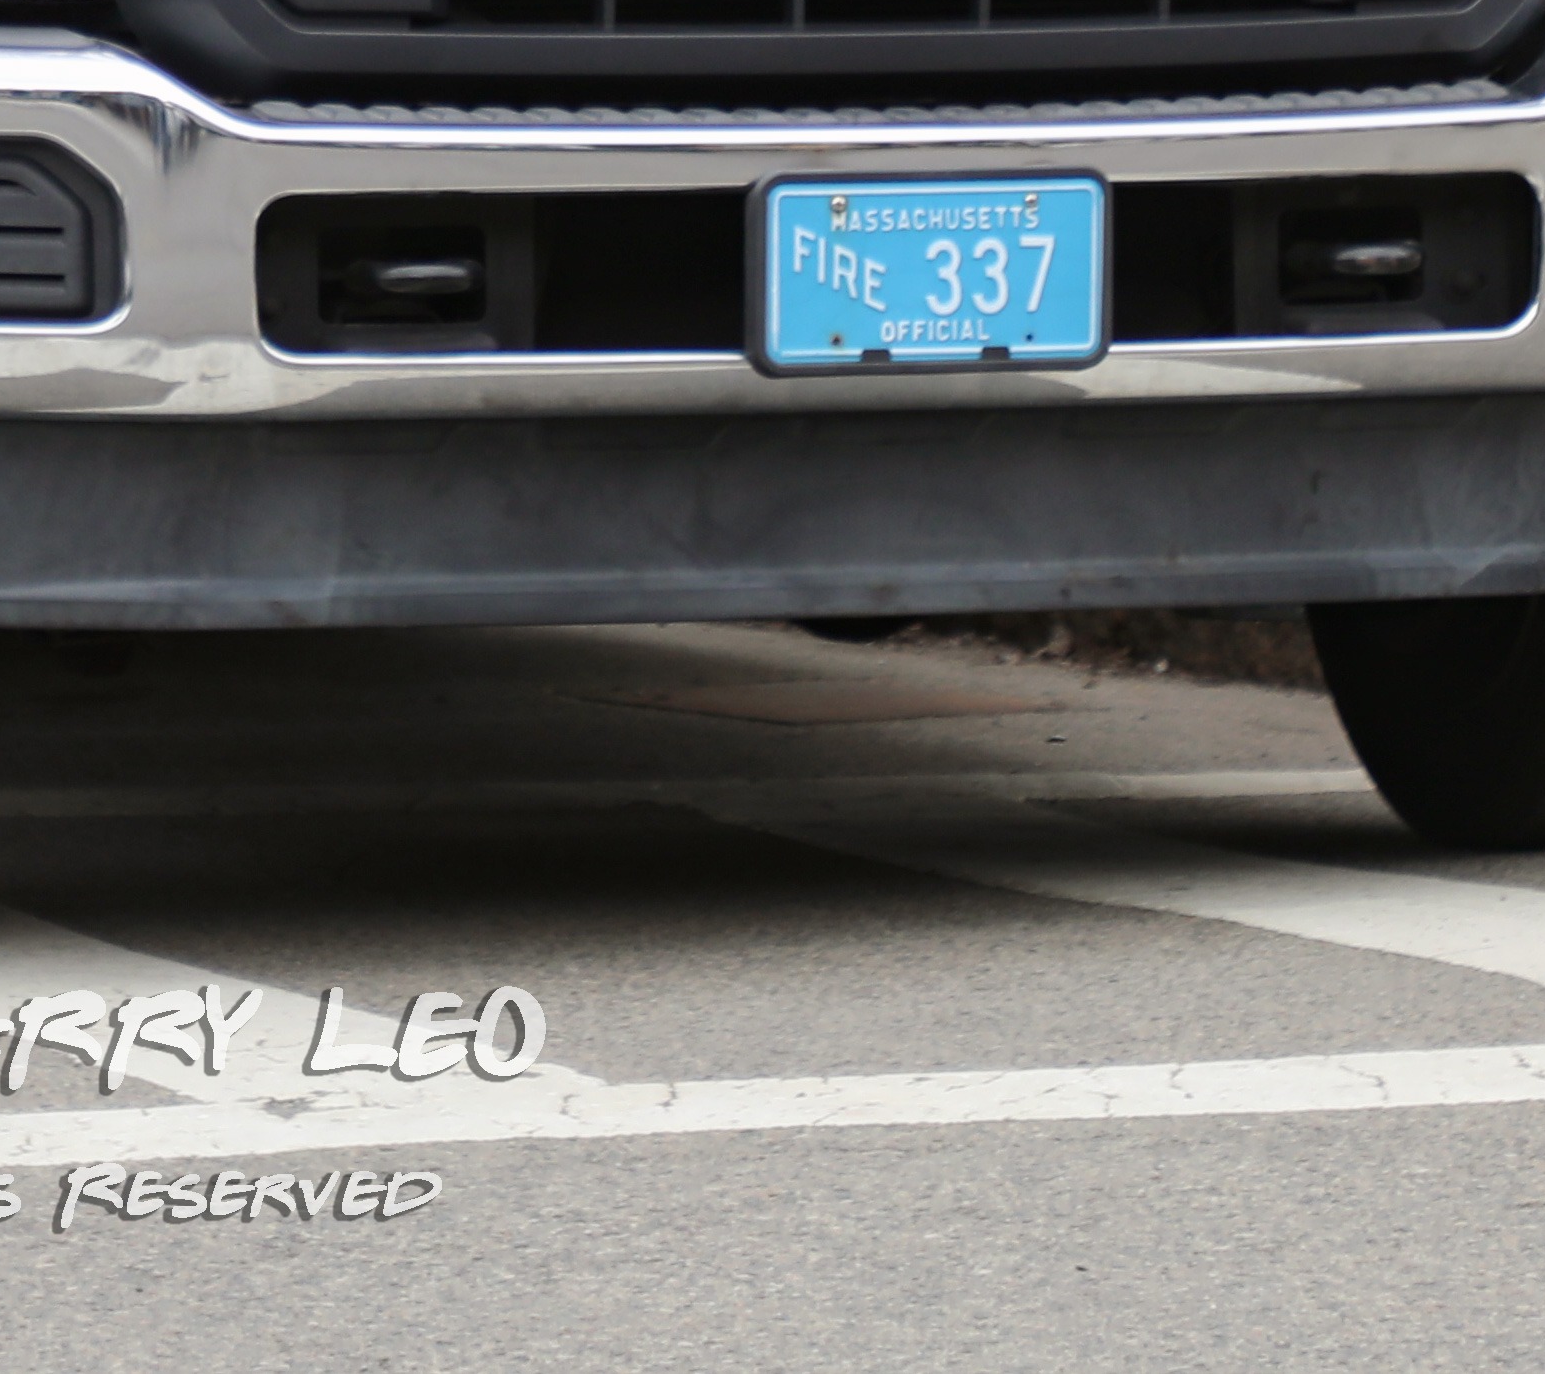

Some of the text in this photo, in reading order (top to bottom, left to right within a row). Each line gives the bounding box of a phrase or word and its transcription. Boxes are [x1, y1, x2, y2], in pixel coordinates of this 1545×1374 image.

[830, 205, 1040, 234] MASSACHUSETTS
[793, 224, 1056, 317] FIRE 337
[880, 317, 990, 344] OFFICIAL
